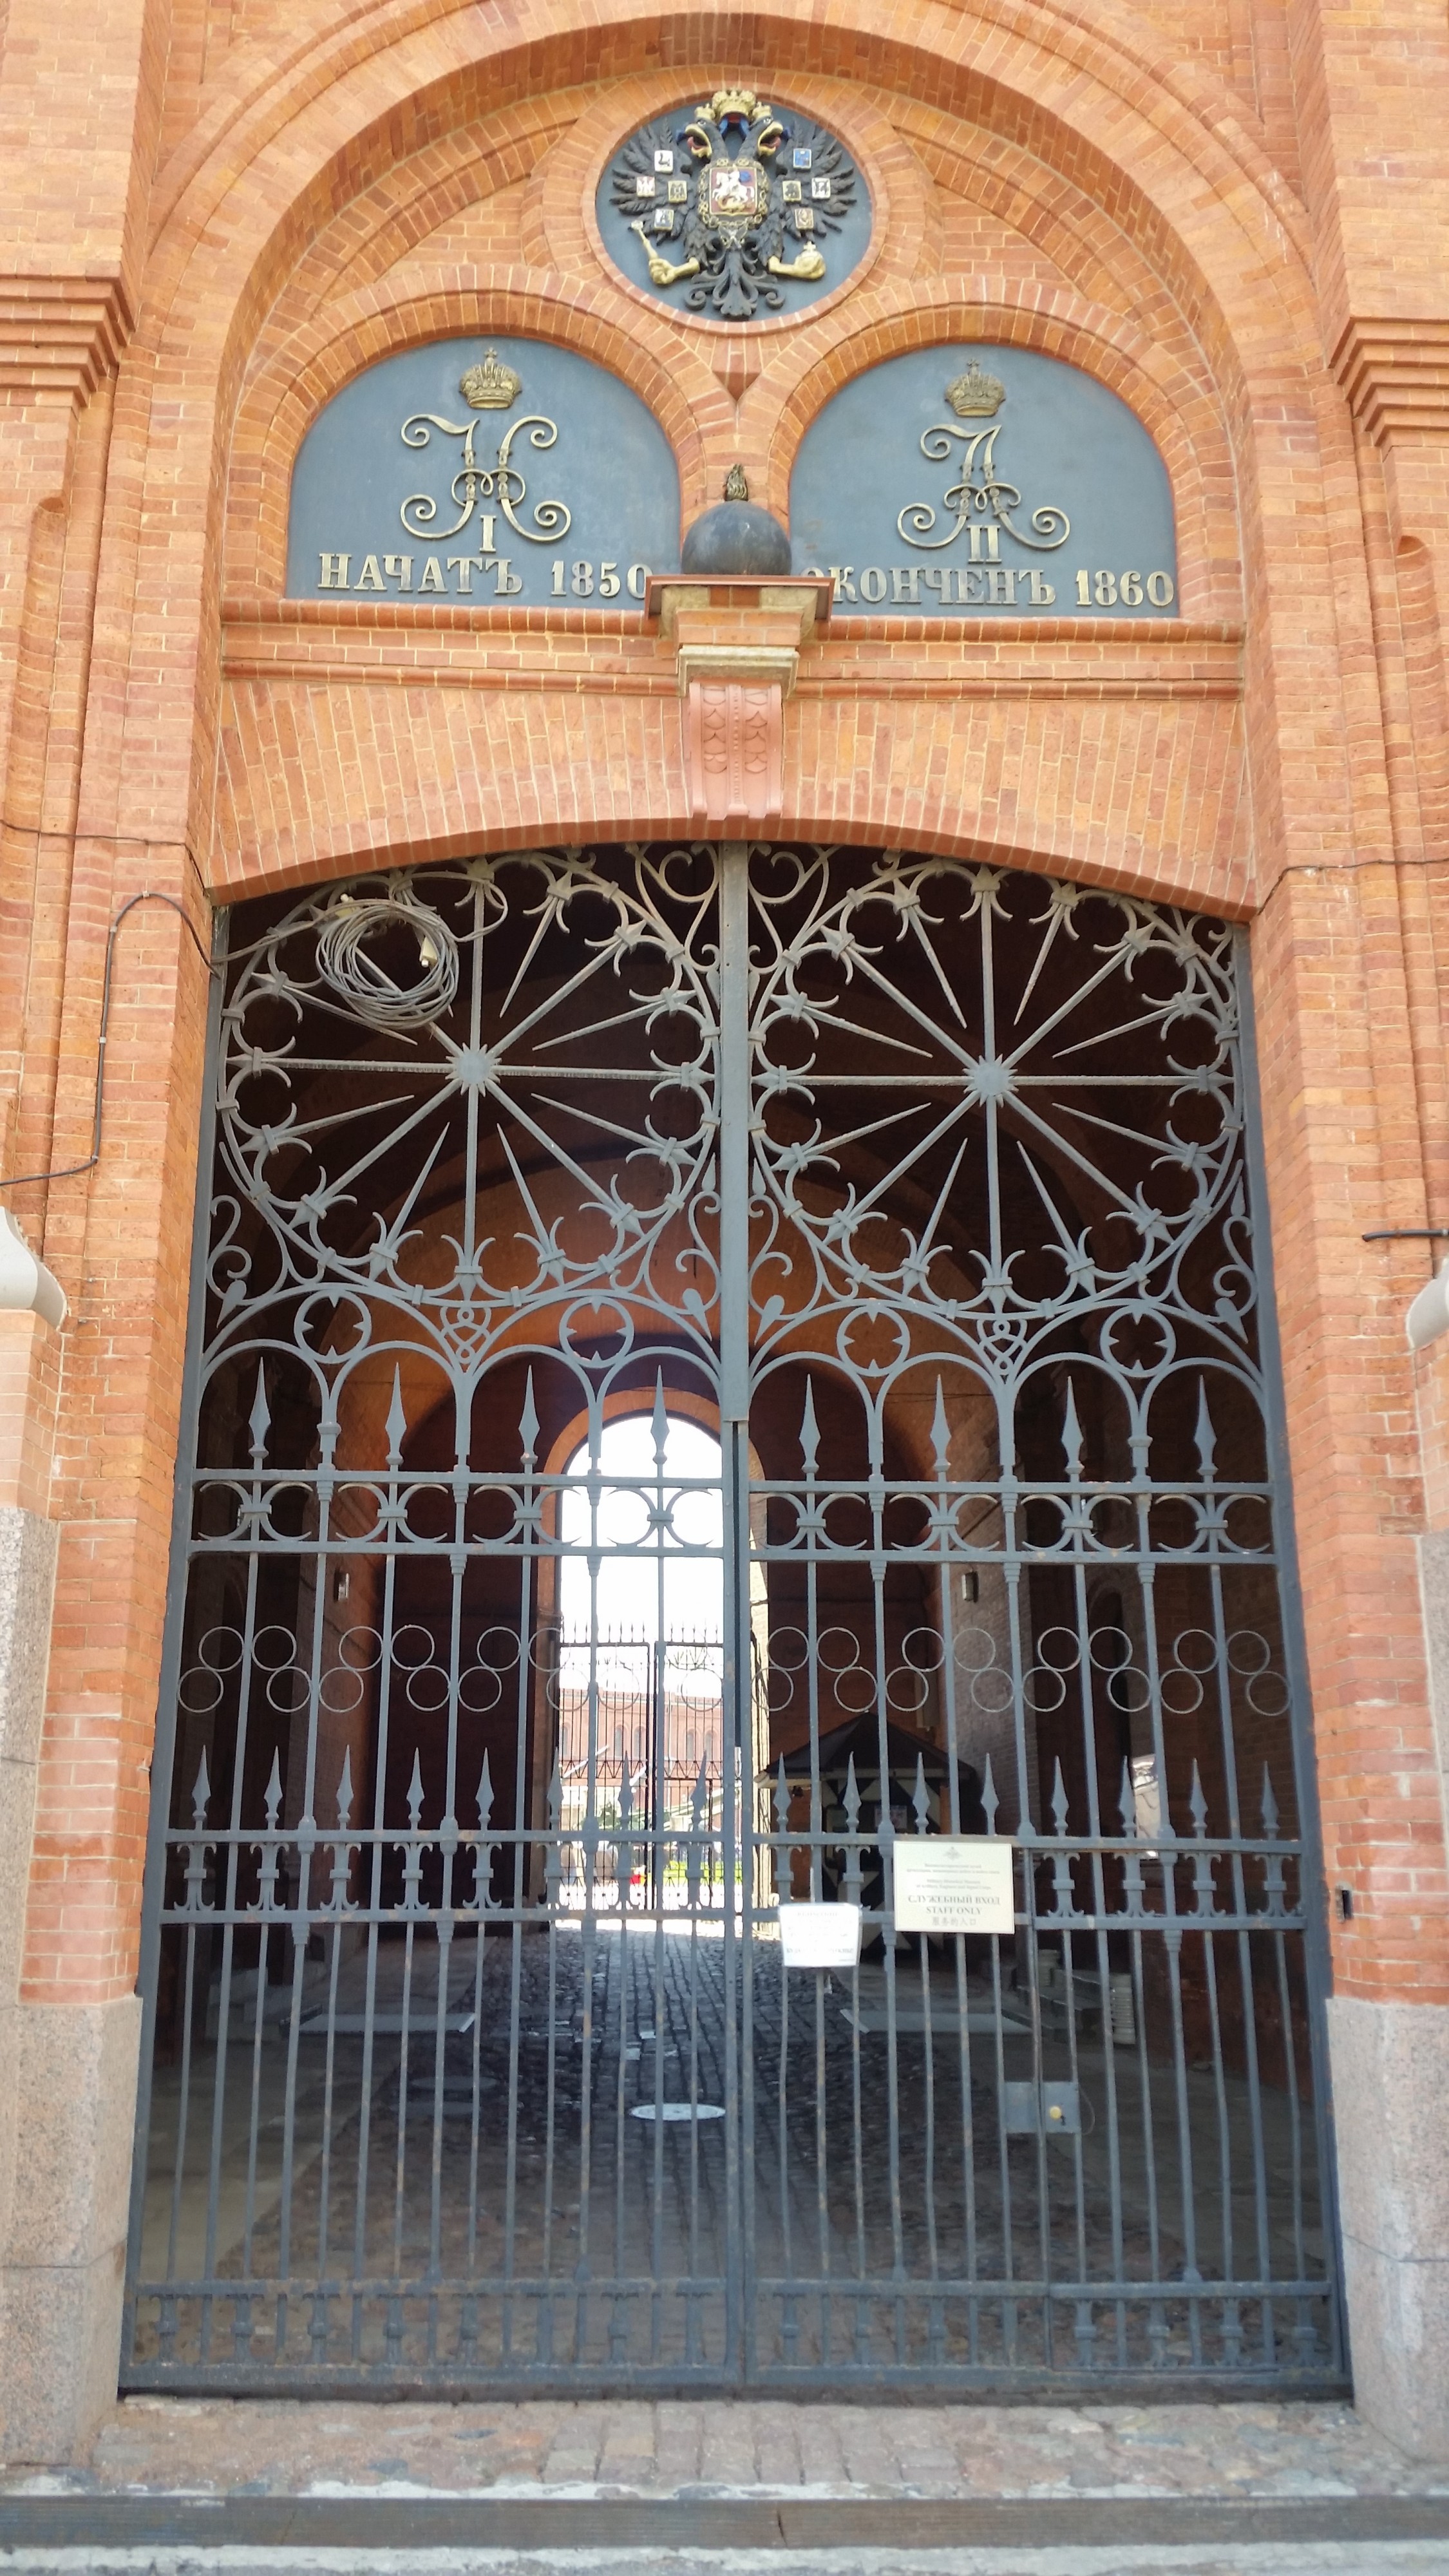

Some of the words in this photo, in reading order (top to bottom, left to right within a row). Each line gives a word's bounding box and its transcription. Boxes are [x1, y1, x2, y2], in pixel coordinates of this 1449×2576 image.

[317, 553, 523, 595] НАЧАТЪ
[551, 560, 654, 600] 1850
[800, 566, 1057, 606] КОНЧЕНЪ
[1075, 569, 1175, 607] 1860
[908, 1895, 972, 1904] СЛУЖЕБНЫЙ
[975, 1896, 1001, 1905] ВХОД
